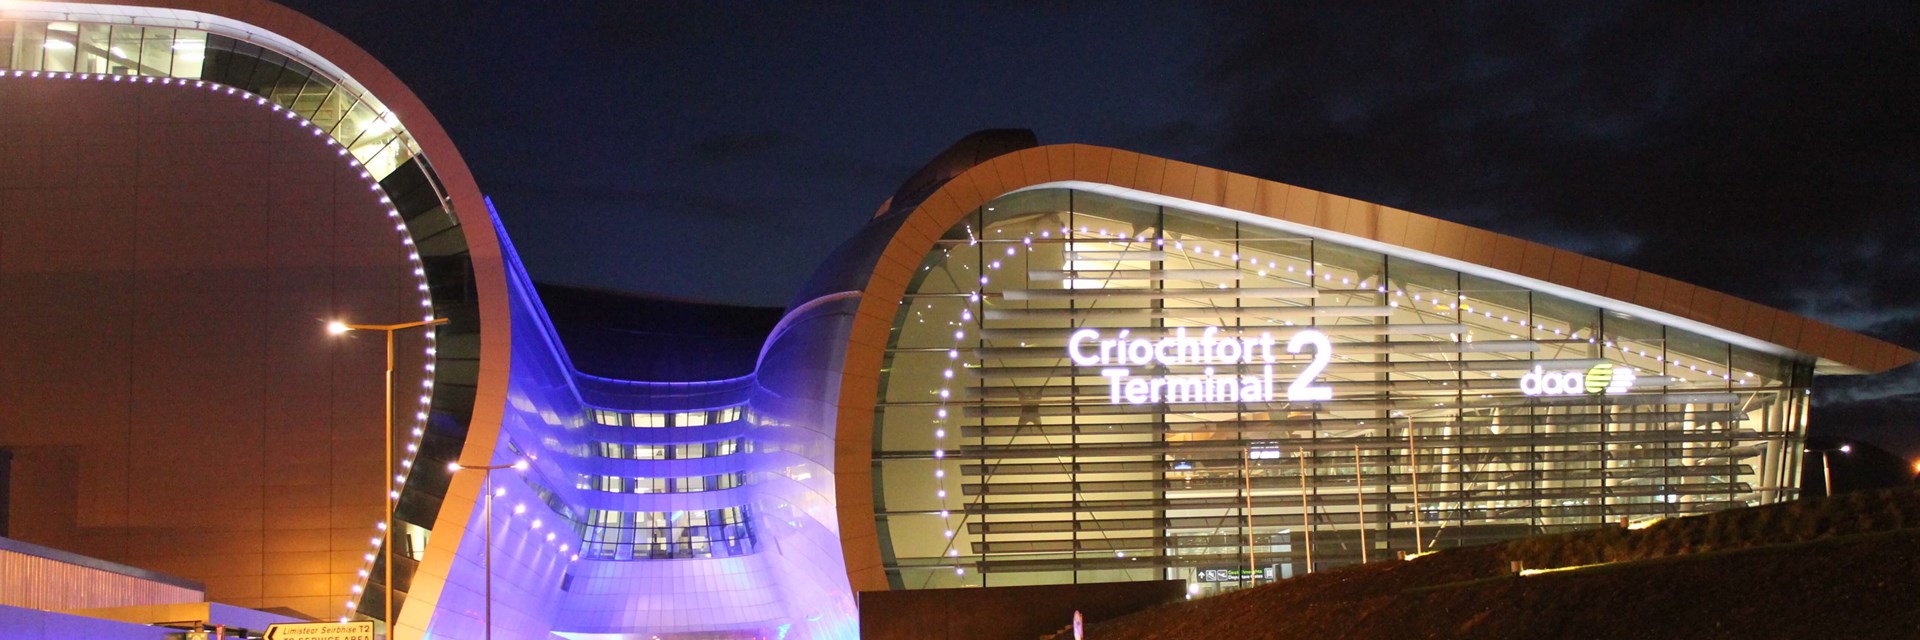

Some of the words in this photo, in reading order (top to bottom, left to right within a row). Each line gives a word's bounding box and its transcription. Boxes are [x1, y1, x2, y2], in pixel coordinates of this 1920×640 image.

[1069, 327, 1276, 366] Críochfort
[1287, 330, 1332, 400] 2
[1101, 364, 1272, 404] Terminal
[1520, 364, 1584, 395] daa
[359, 625, 370, 633] T2
